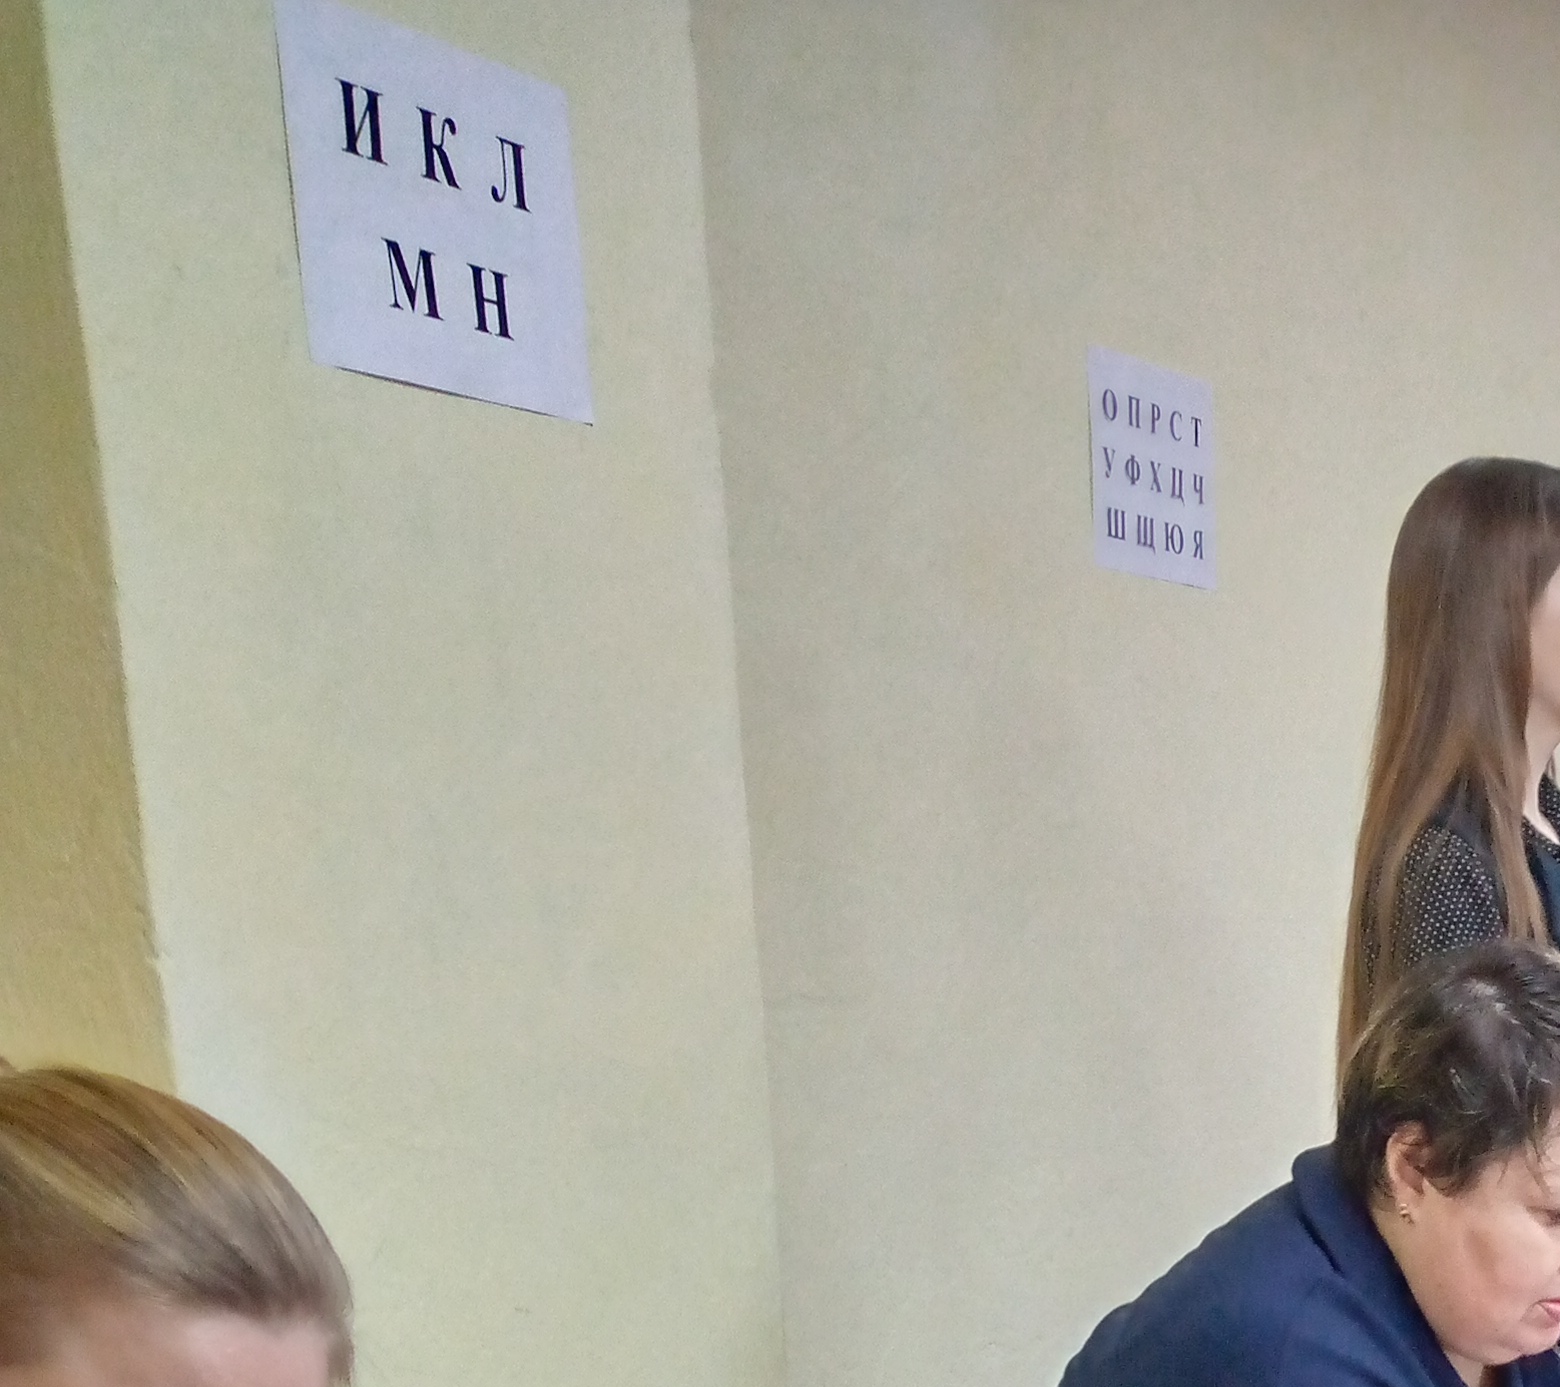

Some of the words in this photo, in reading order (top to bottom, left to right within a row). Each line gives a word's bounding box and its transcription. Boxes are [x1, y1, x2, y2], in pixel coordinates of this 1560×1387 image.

[335, 77, 388, 165] И
[416, 105, 462, 191] К
[491, 136, 532, 213] Л
[381, 237, 444, 321] М
[467, 262, 515, 341] Н
